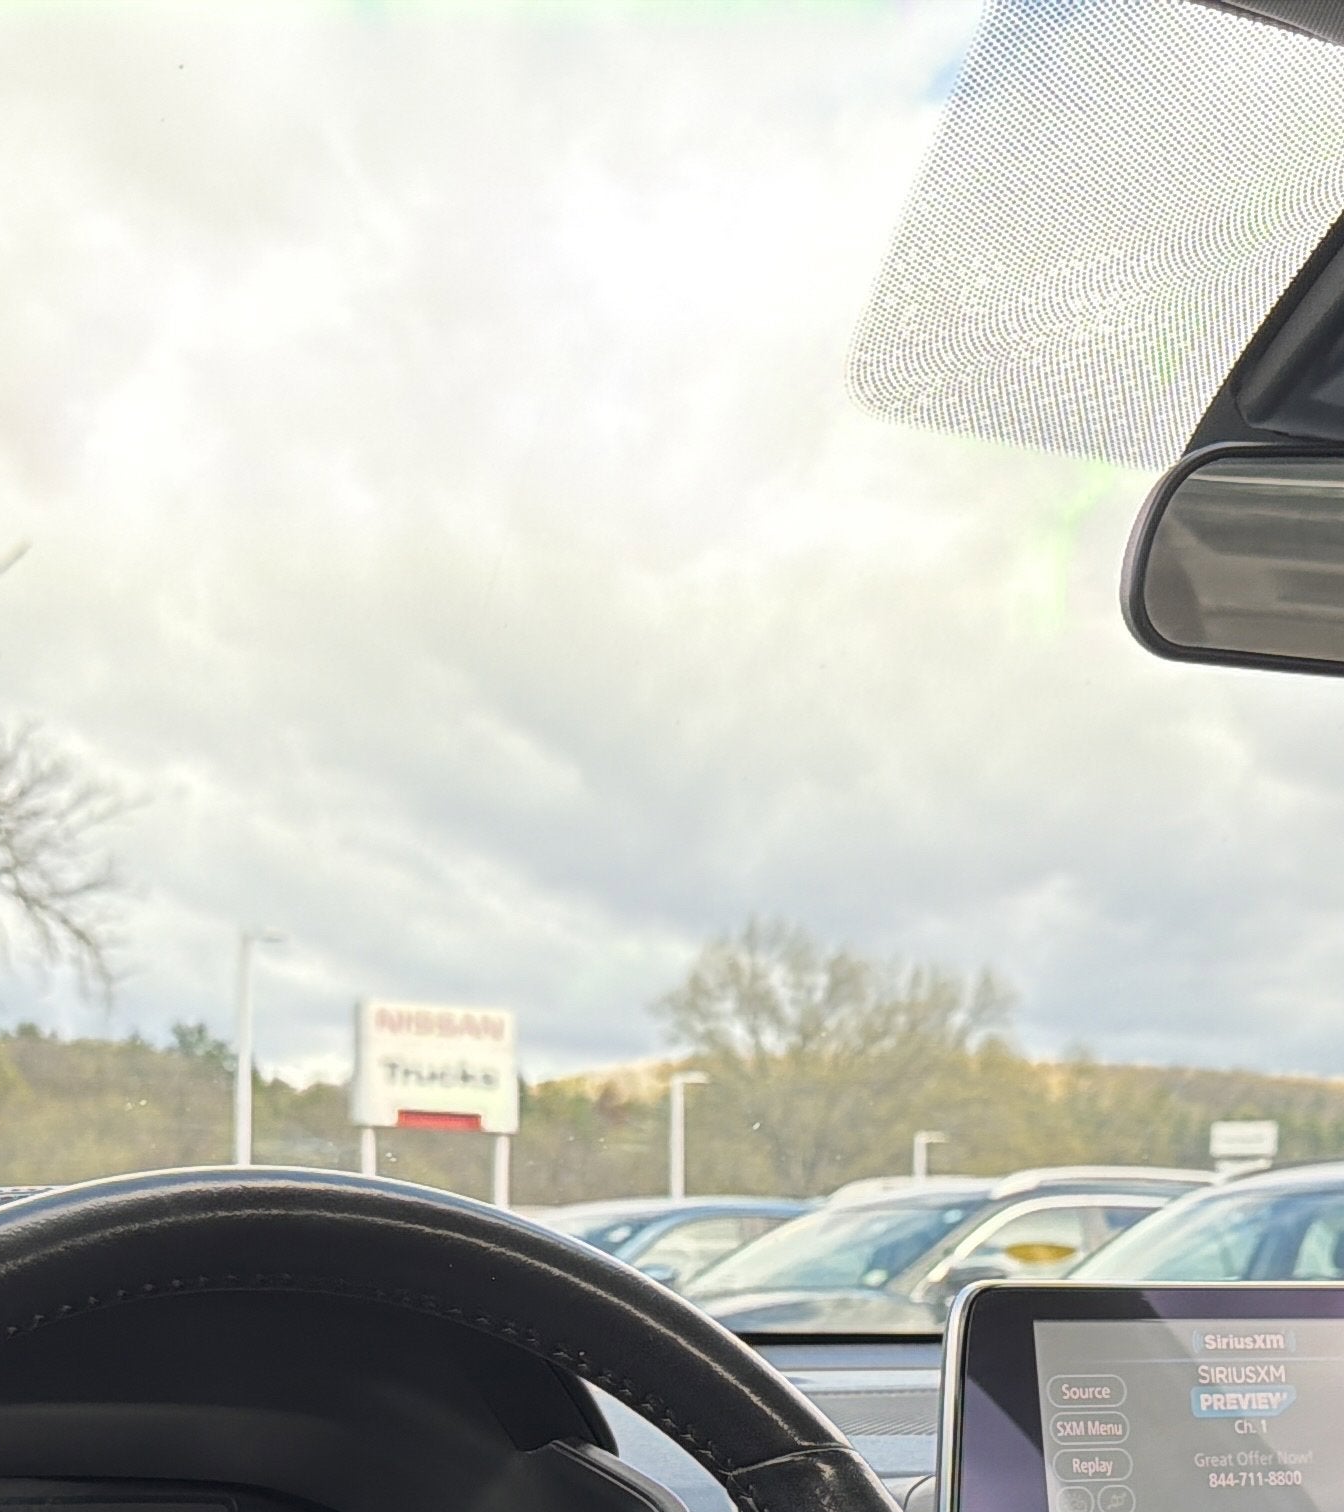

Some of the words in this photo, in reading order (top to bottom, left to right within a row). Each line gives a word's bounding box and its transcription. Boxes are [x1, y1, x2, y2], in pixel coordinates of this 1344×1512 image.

[374, 1008, 505, 1041] NISSAN
[384, 1061, 499, 1090] Trucks
[1060, 1383, 1111, 1400] Source
[1199, 1392, 1287, 1411] PREVIEW
[1056, 1421, 1085, 1437] SXM
[1087, 1420, 1123, 1436] Menu
[1072, 1457, 1113, 1477] Replay
[1194, 1452, 1233, 1469] Great
[1236, 1452, 1273, 1468] Offer
[1276, 1450, 1314, 1466] Now!
[1208, 1471, 1302, 1489] 844-711-8800
